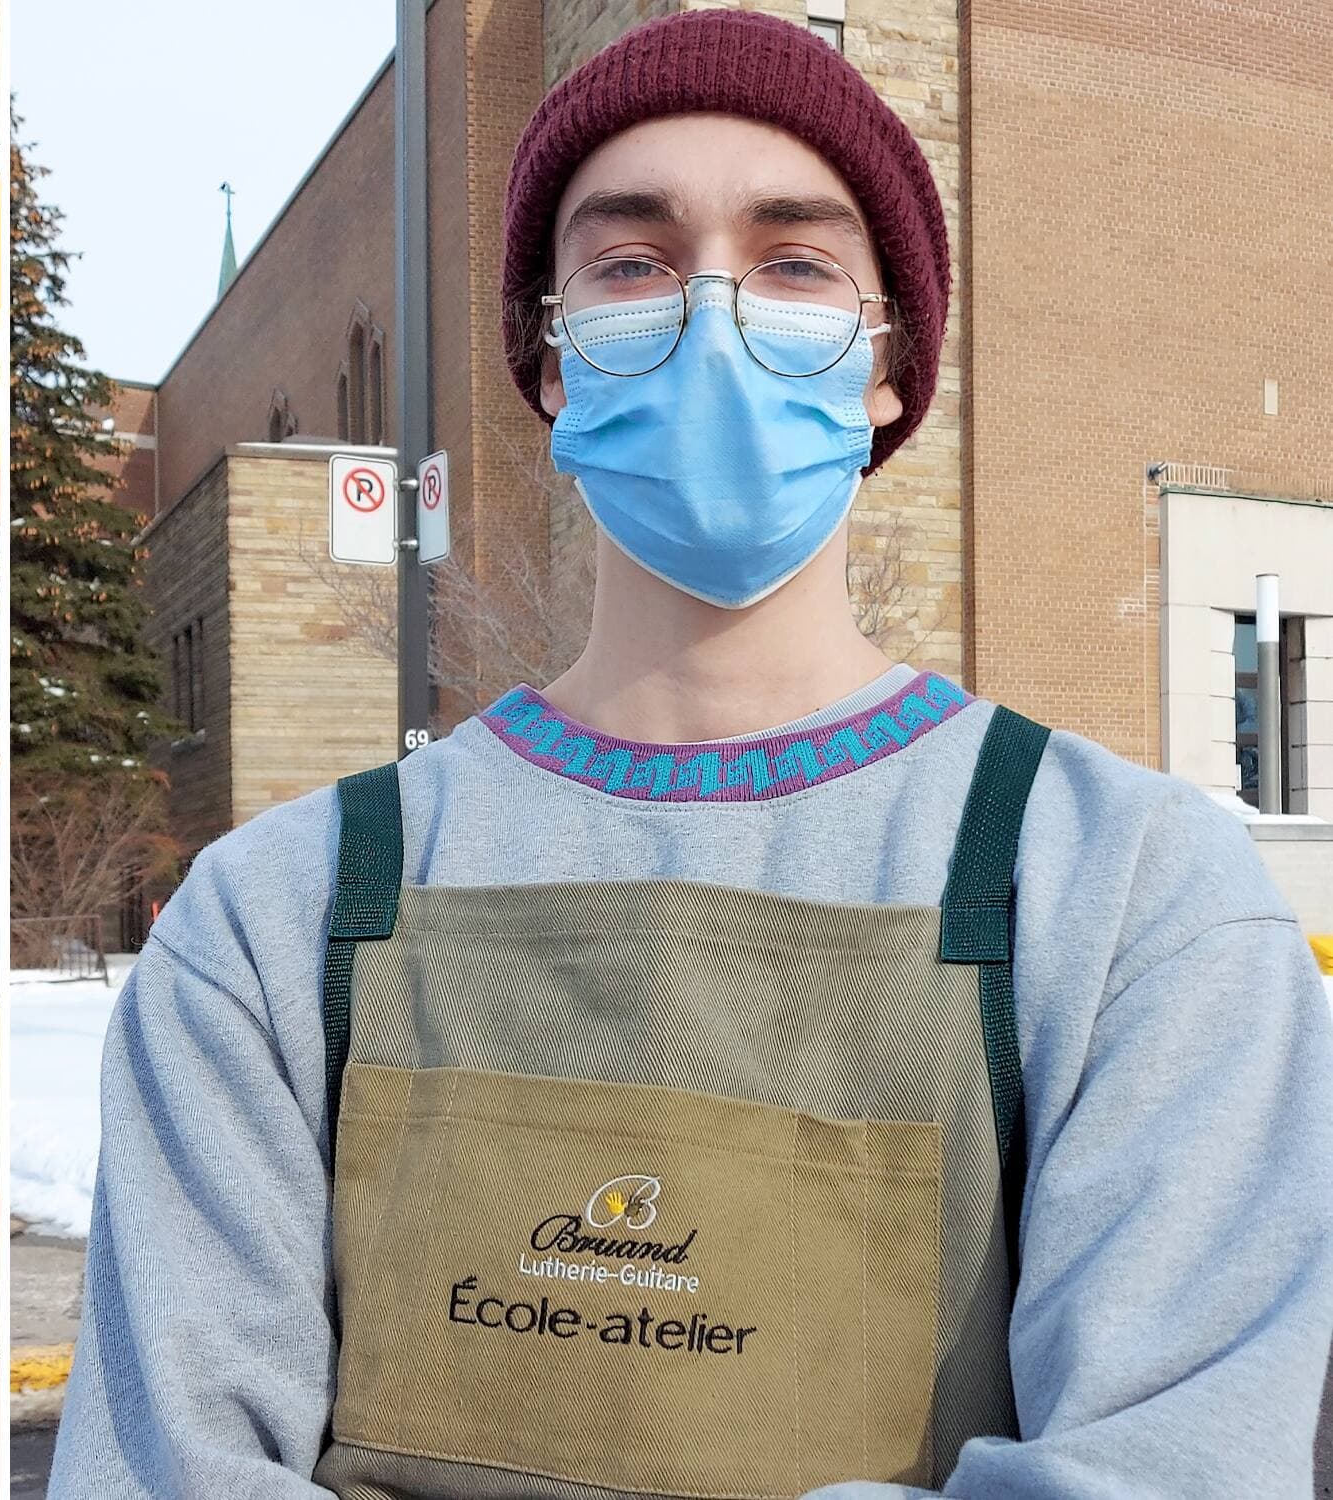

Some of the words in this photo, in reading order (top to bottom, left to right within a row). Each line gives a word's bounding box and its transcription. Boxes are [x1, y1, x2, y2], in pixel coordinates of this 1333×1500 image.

[356, 477, 373, 502] P
[405, 729, 429, 750] 69
[530, 1214, 698, 1264] Bruand
[519, 1254, 700, 1293] Lutherie-Guitare
[449, 1275, 757, 1354] École-atelier
